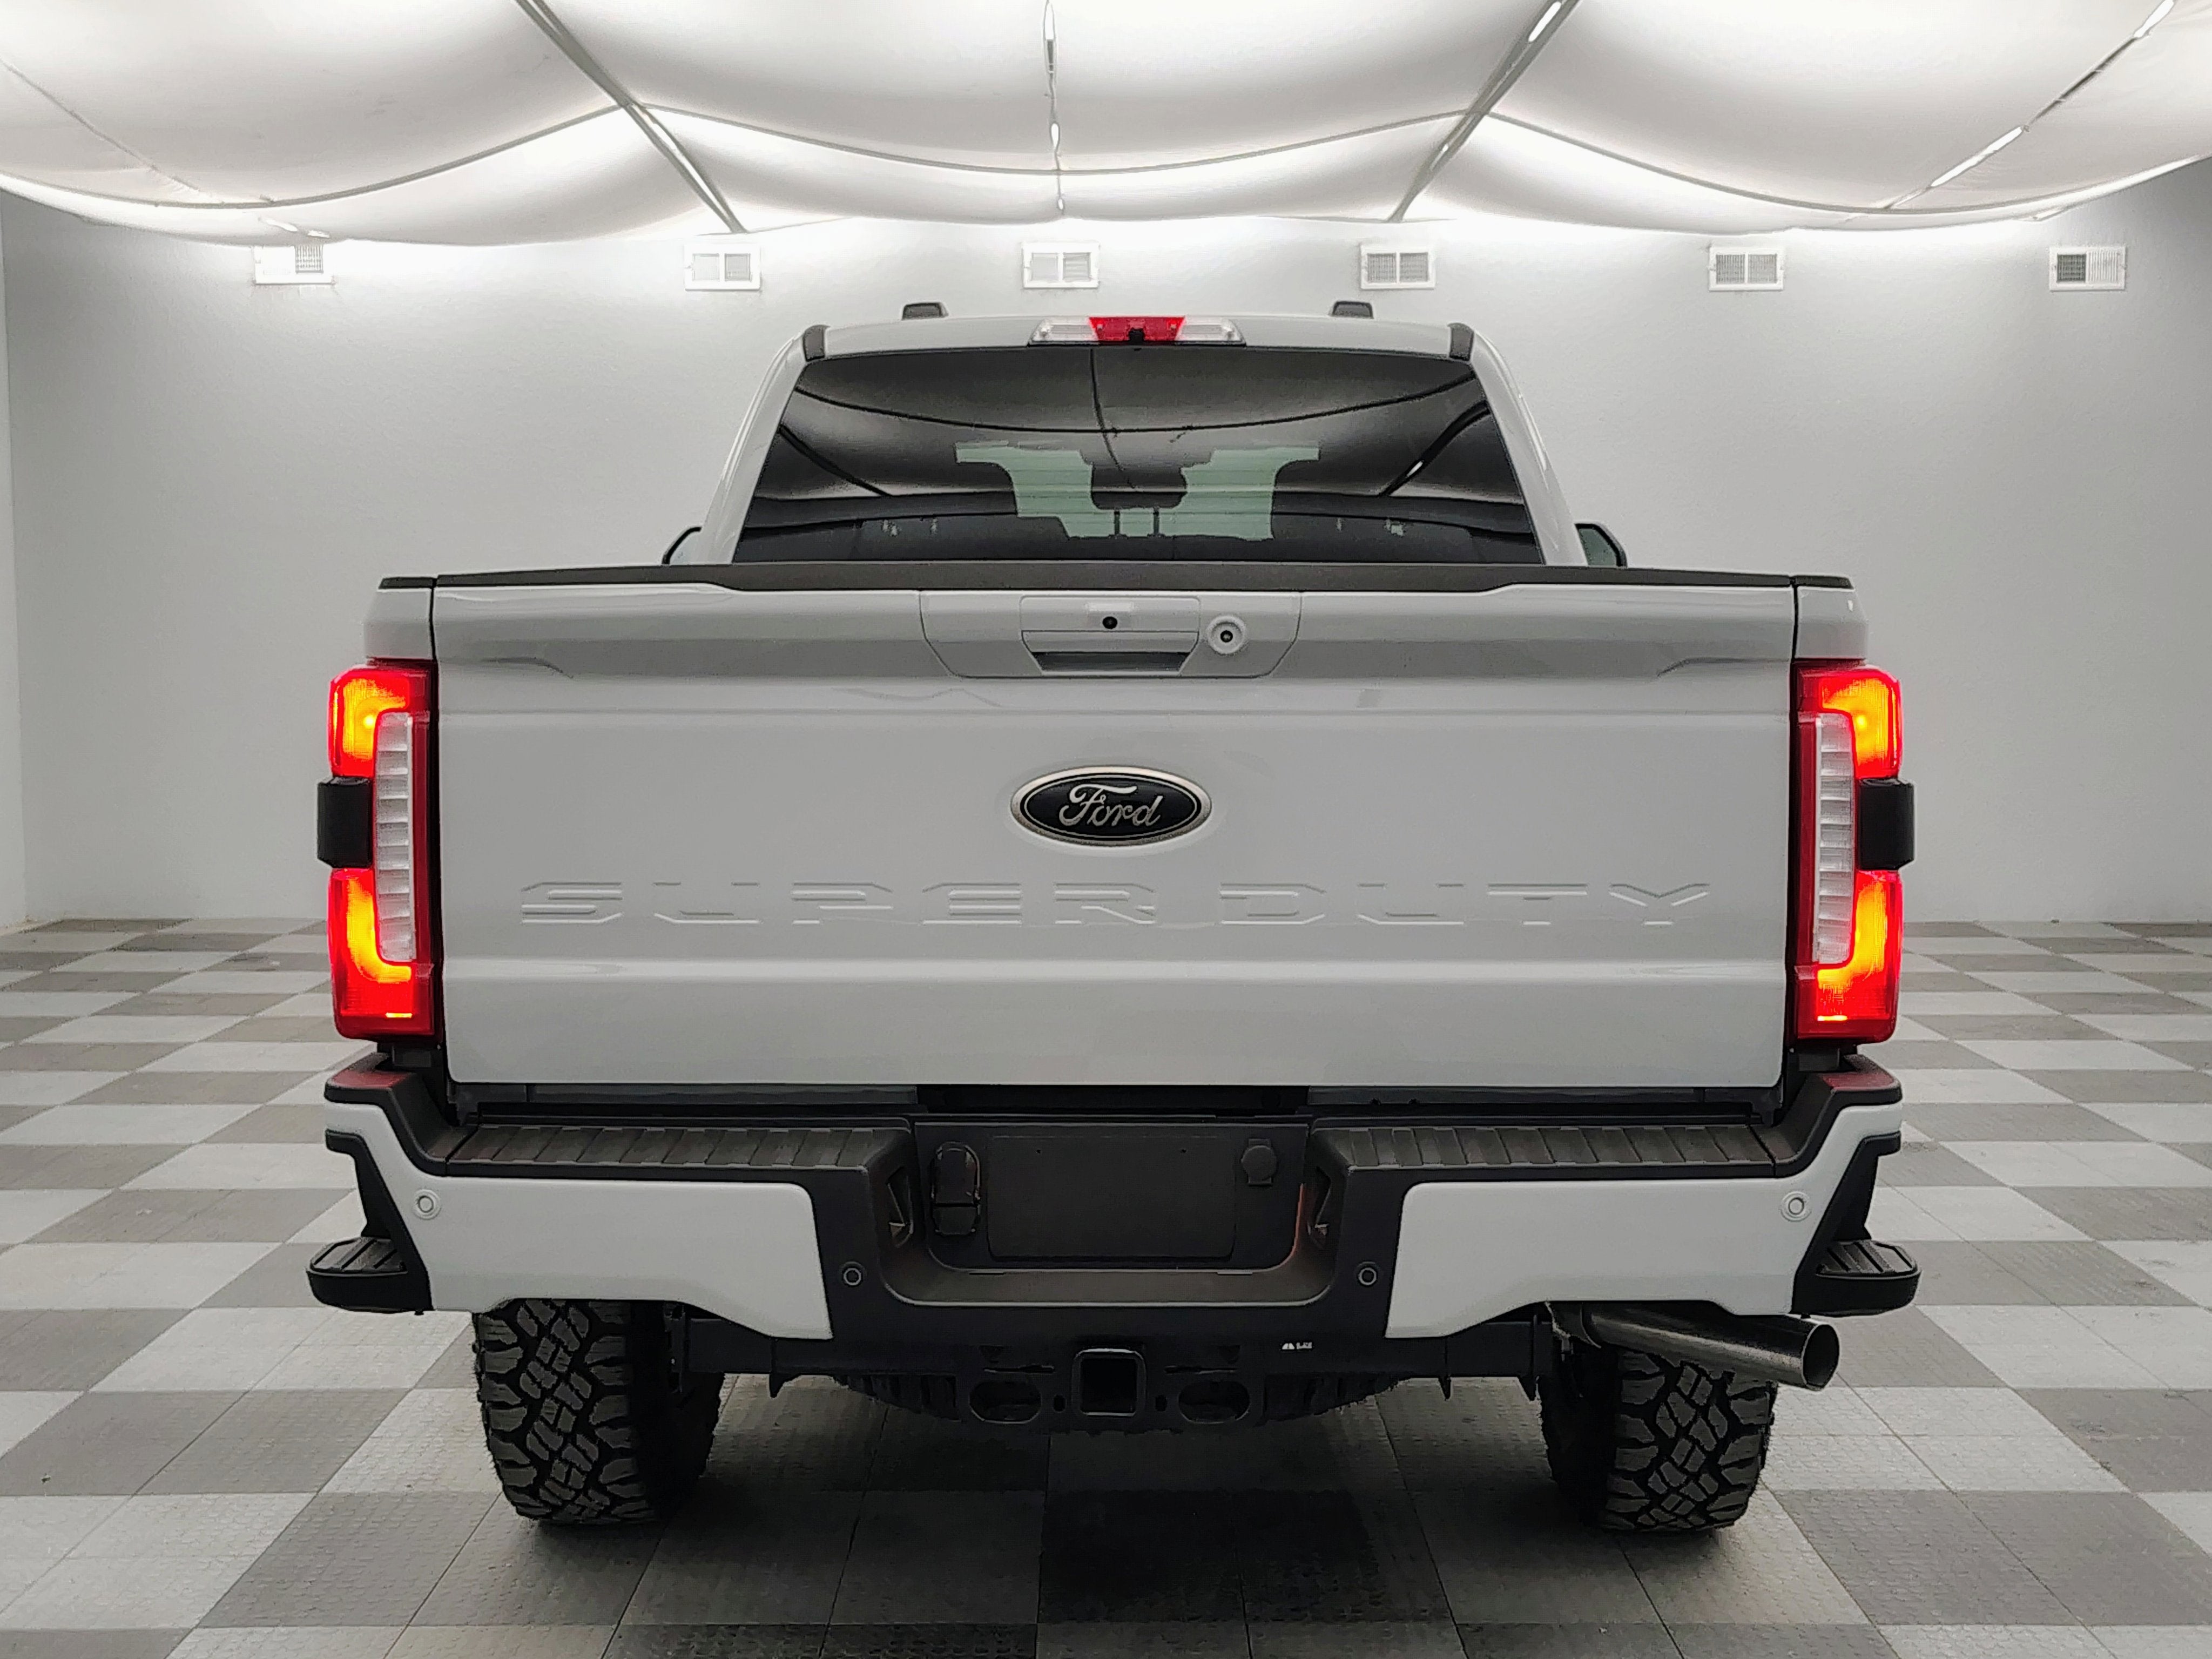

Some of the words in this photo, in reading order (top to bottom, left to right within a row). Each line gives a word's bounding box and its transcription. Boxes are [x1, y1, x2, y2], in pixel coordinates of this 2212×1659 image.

[1059, 784, 1164, 826] Ford
[521, 881, 1155, 925] SUPER
[1219, 882, 1710, 926] DUTY
